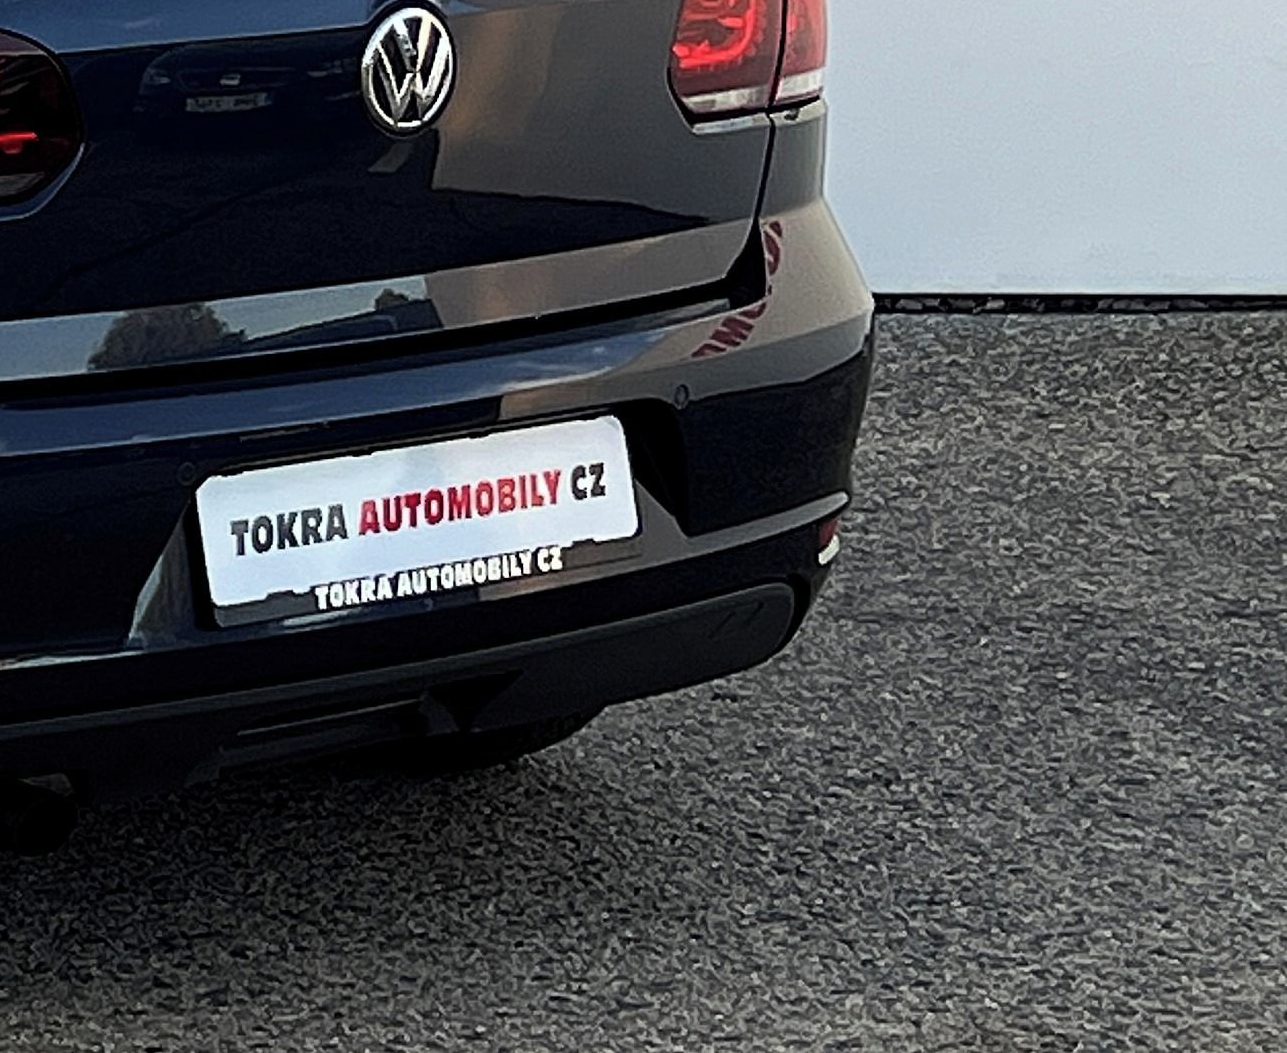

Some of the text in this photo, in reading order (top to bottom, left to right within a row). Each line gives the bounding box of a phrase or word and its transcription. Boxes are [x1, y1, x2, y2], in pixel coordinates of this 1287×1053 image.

[230, 462, 607, 556] TOKRA AUTOMOBILY CZ
[314, 547, 563, 610] TOKRA AUTOMOBILY CZ
